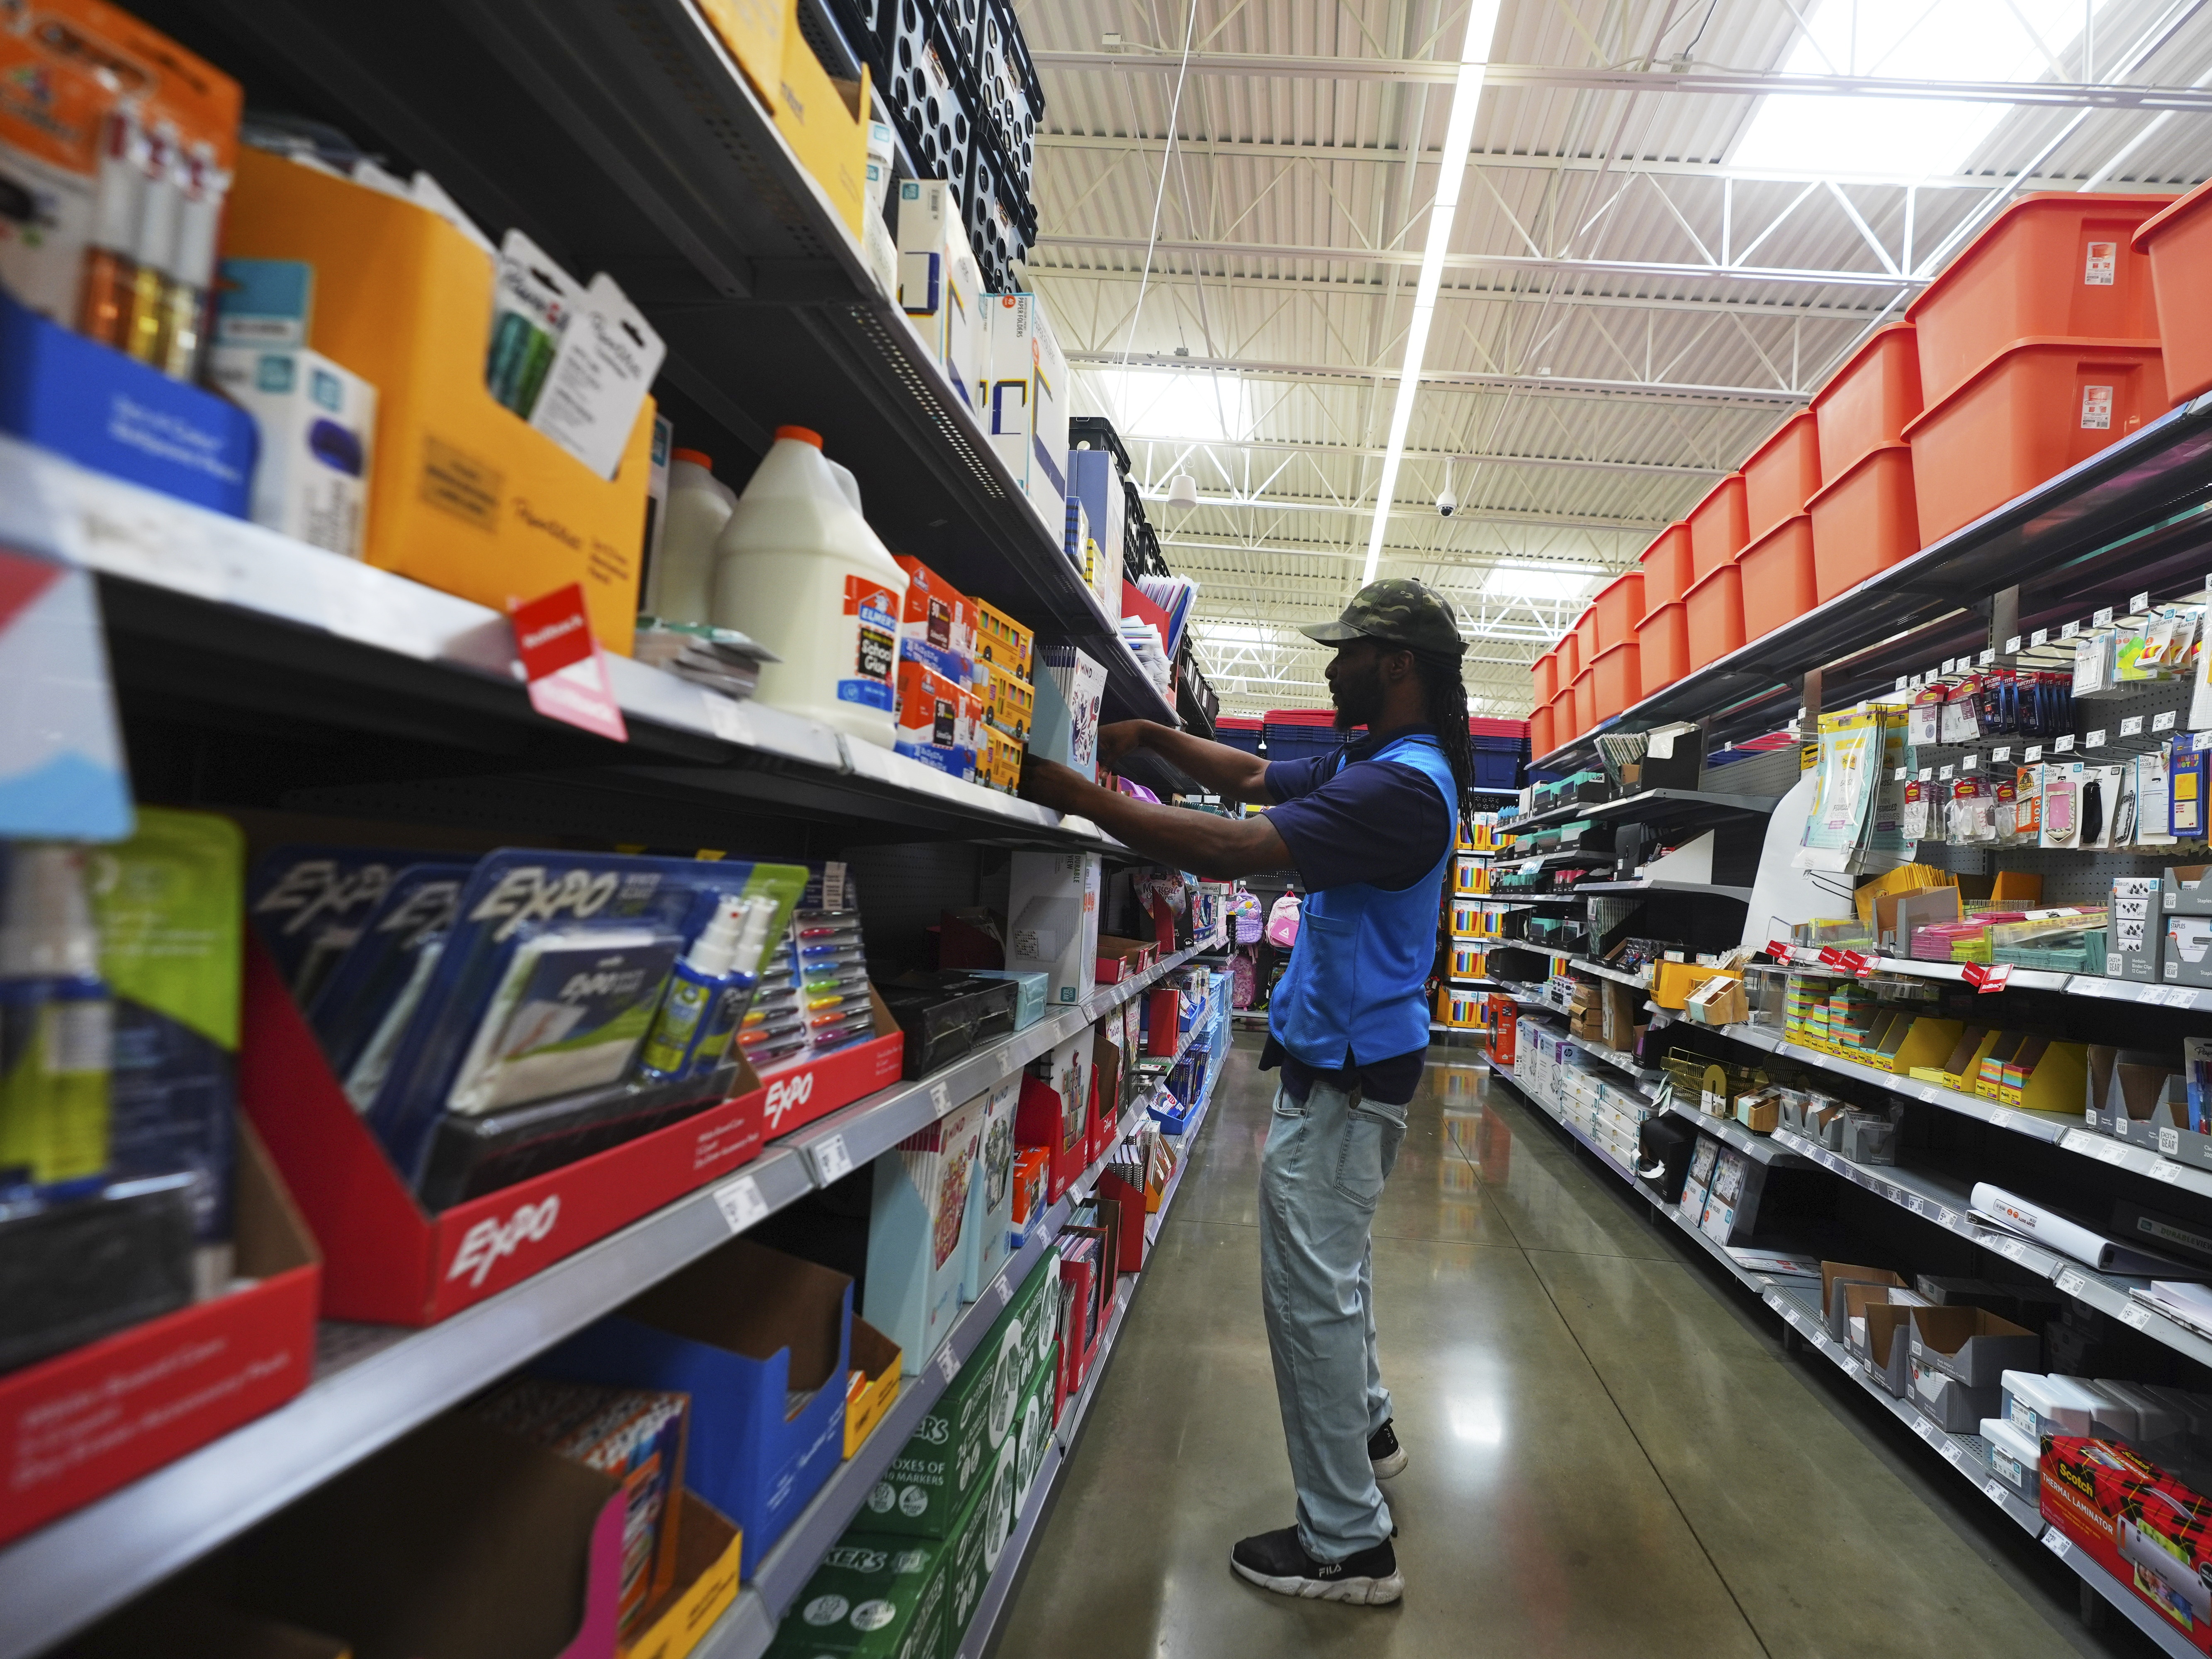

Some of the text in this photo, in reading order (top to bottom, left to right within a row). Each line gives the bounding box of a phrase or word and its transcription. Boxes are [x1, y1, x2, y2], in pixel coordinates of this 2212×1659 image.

[2149, 619, 2172, 628] HIGHLIGHTER
[864, 654, 887, 674] Glue
[1080, 662, 1105, 688] MIND WAVES
[1984, 676, 2001, 685] LOCTITE
[2017, 678, 2037, 687] LOCTITE
[2178, 754, 2199, 762] LUNCH
[470, 867, 618, 942] EXPO
[1822, 951, 1835, 961] Rollback
[1844, 956, 1858, 965] Rollback
[2108, 956, 2120, 965] pen+
[2109, 963, 2120, 972] GEAR
[1964, 968, 1981, 980] Rollback
[1981, 983, 2003, 991] Rollback
[1565, 1048, 1572, 1057] hp
[764, 1072, 814, 1130] EXPO
[2161, 1130, 2176, 1140] pen+
[2162, 1140, 2175, 1150] GEAR
[446, 1194, 560, 1287] EXPO
[2161, 1228, 2195, 1245] DURABLE
[1955, 1372, 1966, 1380] Cards
[893, 1458, 946, 1474] OXES OF
[2093, 1440, 2149, 1480] THERMAL LAMINATOR
[2121, 1451, 2151, 1470] Scotch
[896, 1473, 944, 1486] MARKERS
[2059, 1463, 2093, 1498] Scotch
[2042, 1472, 2071, 1503] THERMAL
[2073, 1496, 2113, 1535] LAMINATOR
[1319, 1563, 1341, 1578] FILA
